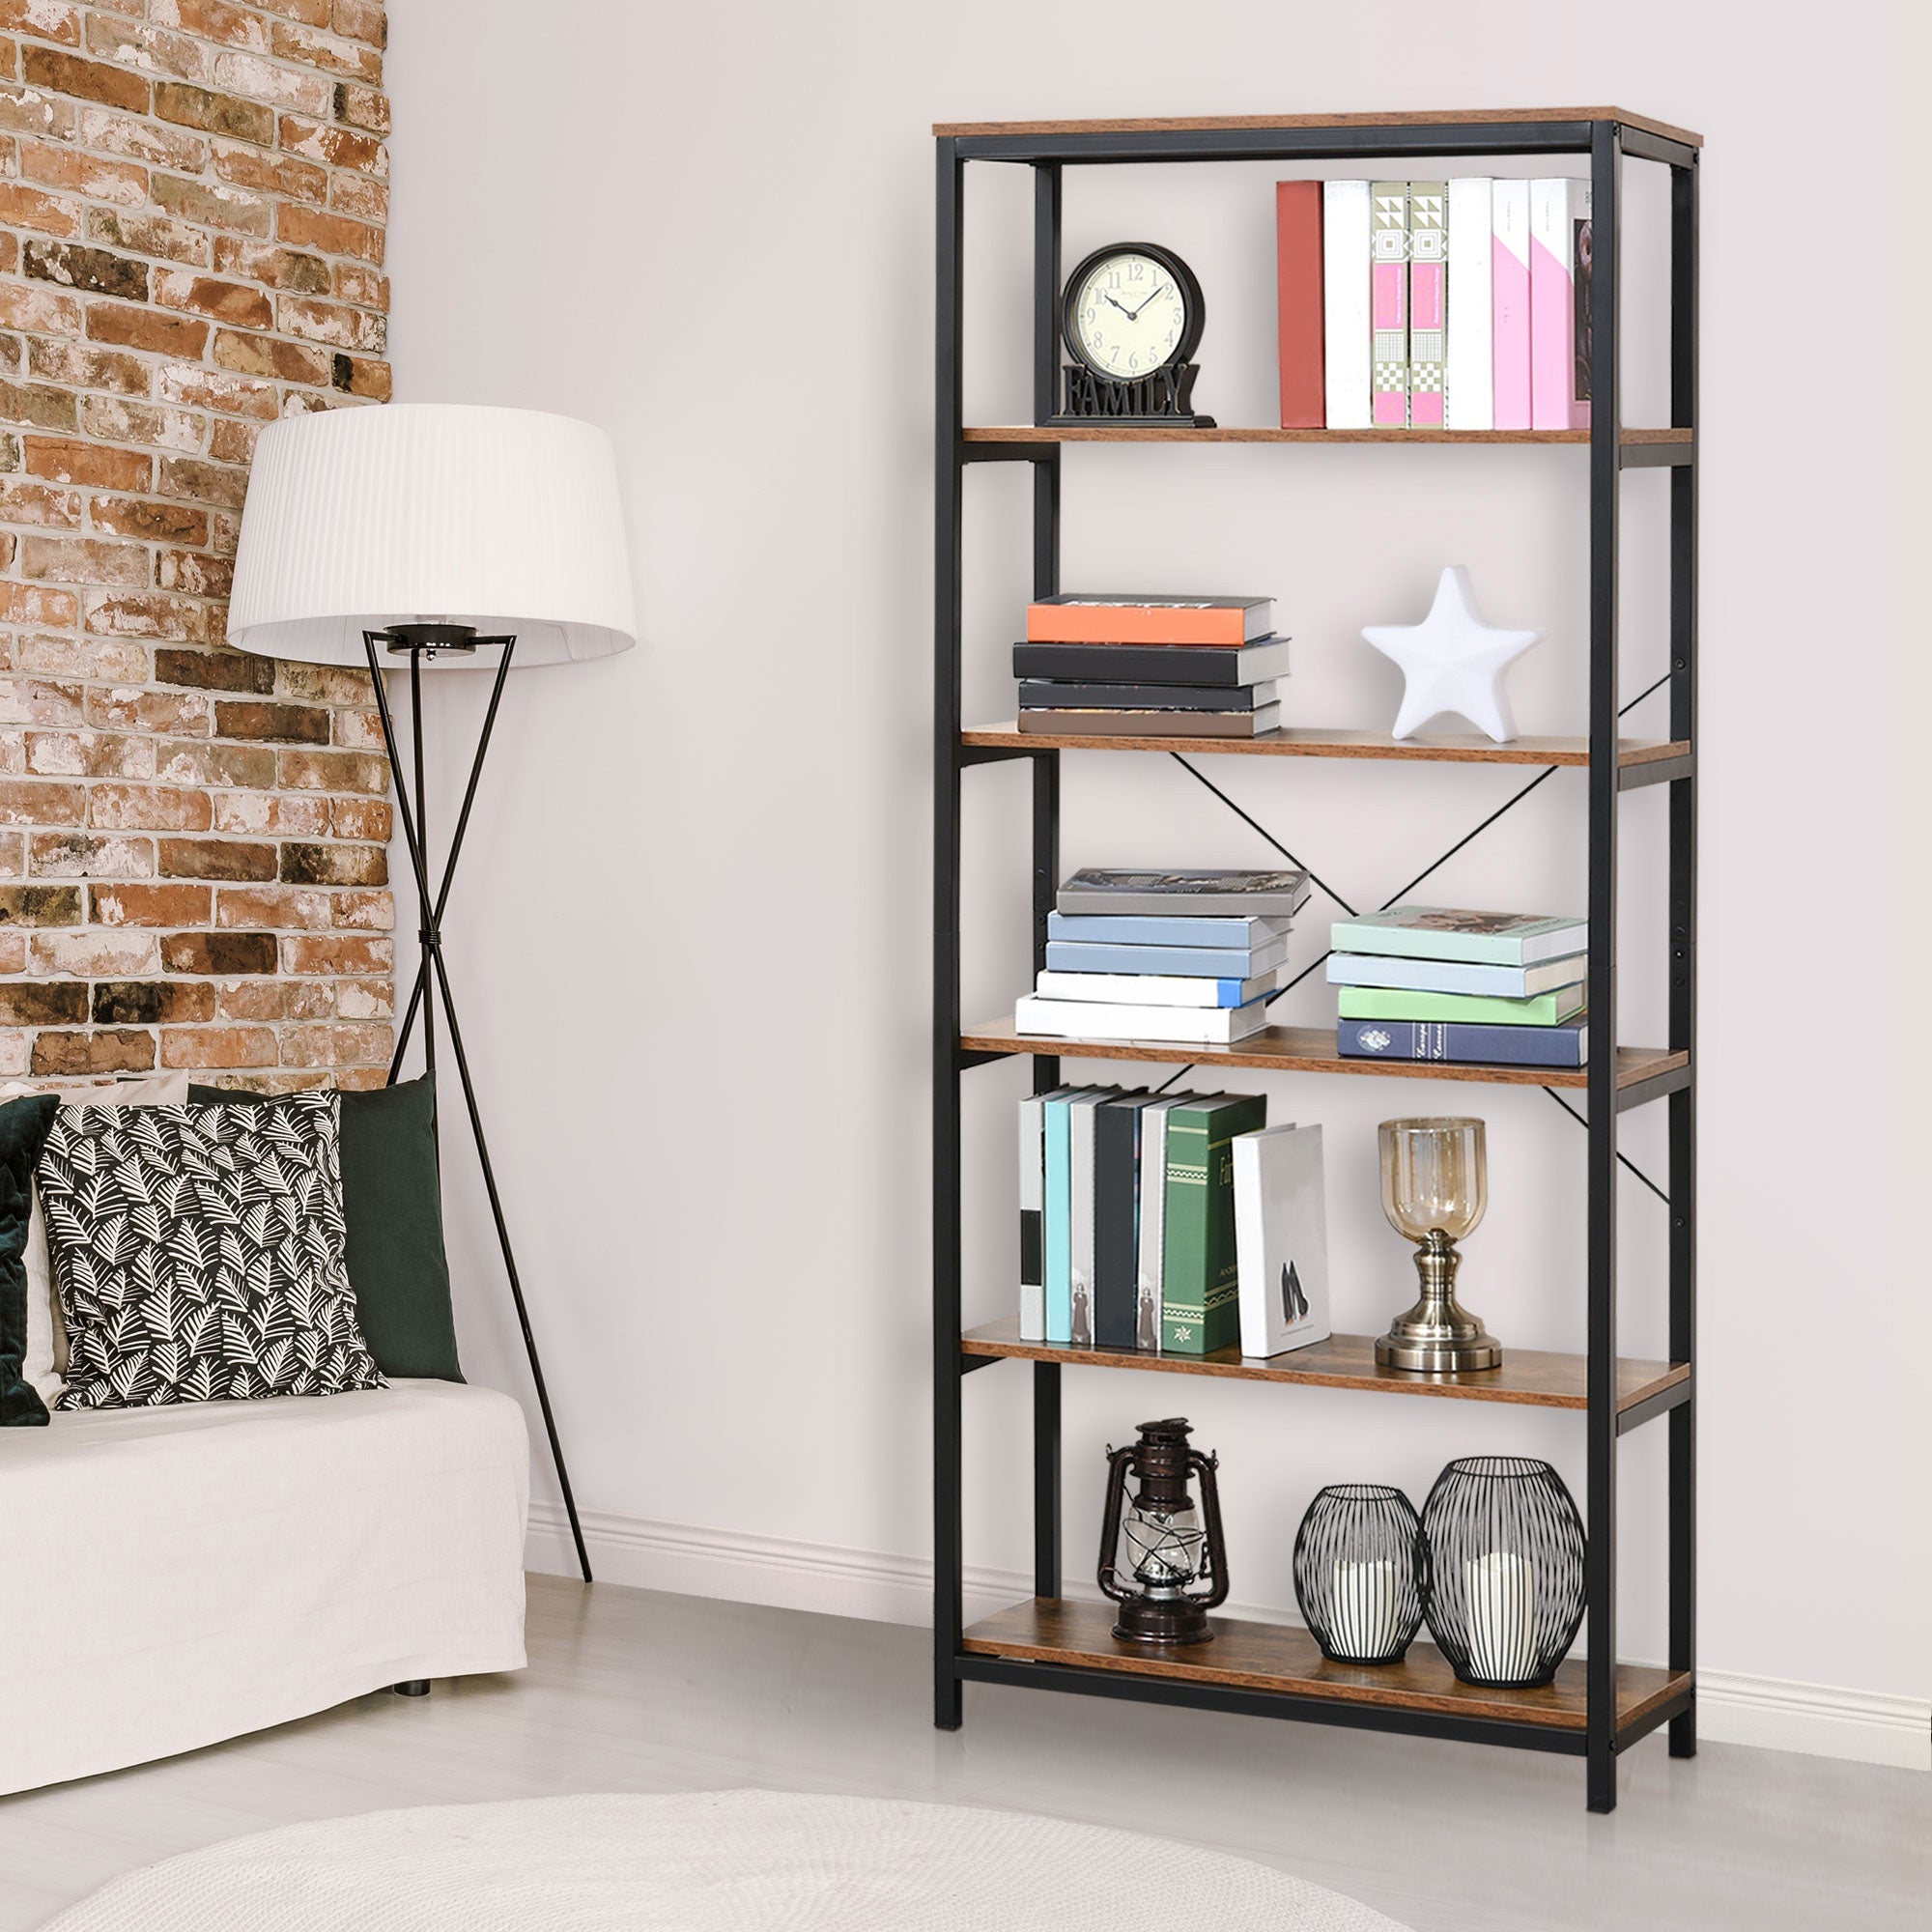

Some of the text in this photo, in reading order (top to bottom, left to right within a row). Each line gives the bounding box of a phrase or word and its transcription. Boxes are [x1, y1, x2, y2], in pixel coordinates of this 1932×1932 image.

[1108, 271, 1122, 289] 11
[1126, 264, 1144, 281] 12
[1151, 270, 1158, 287] 1
[1094, 287, 1109, 305] 10
[1164, 283, 1175, 301] 2
[1086, 307, 1095, 325] 9
[1173, 307, 1181, 326] 3
[1094, 331, 1103, 349] 8
[1164, 329, 1175, 348] 4
[1111, 346, 1121, 363] 7
[1128, 351, 1139, 369] 6
[1149, 347, 1158, 364] 5
[1063, 364, 1190, 415] FAMILY
